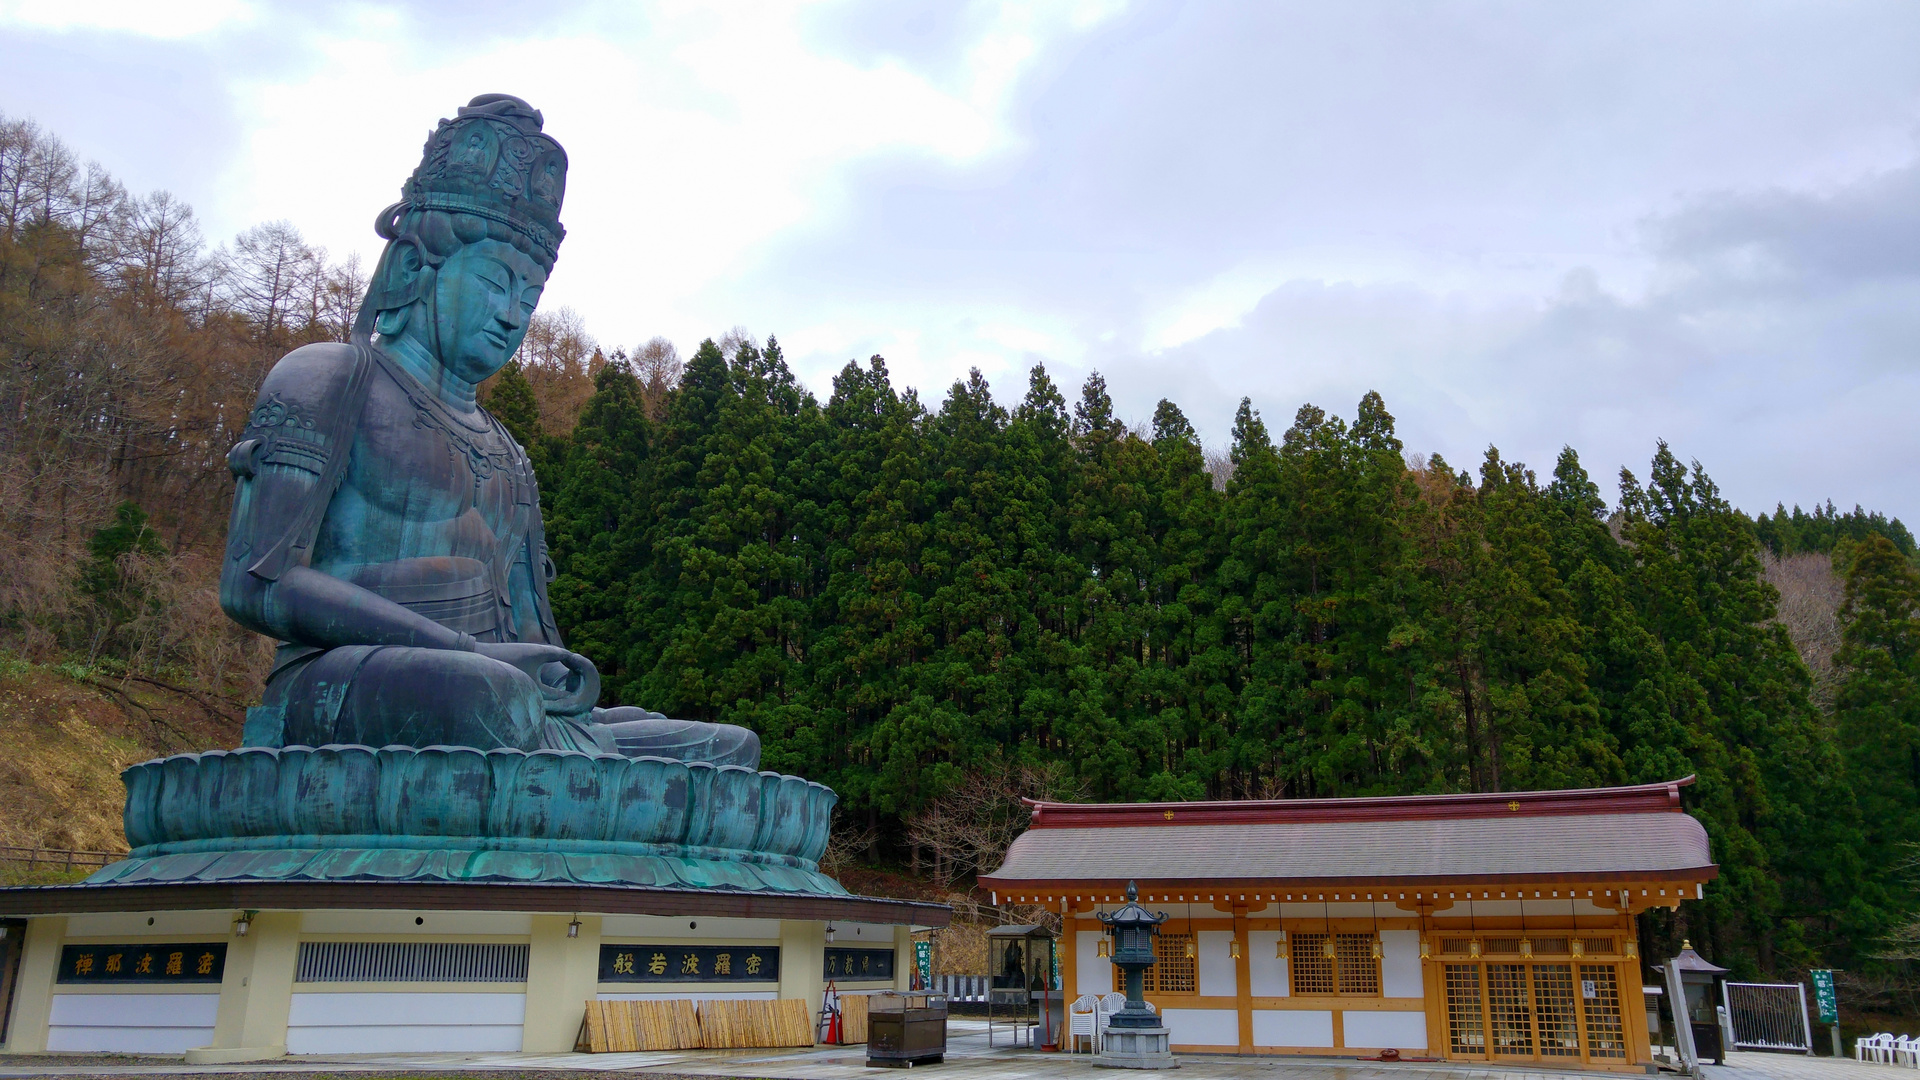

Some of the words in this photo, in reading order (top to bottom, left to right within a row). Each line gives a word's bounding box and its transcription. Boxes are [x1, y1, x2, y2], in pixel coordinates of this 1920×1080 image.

[75, 951, 215, 975] 禅那波羅密
[613, 952, 763, 975] 般若波羅密
